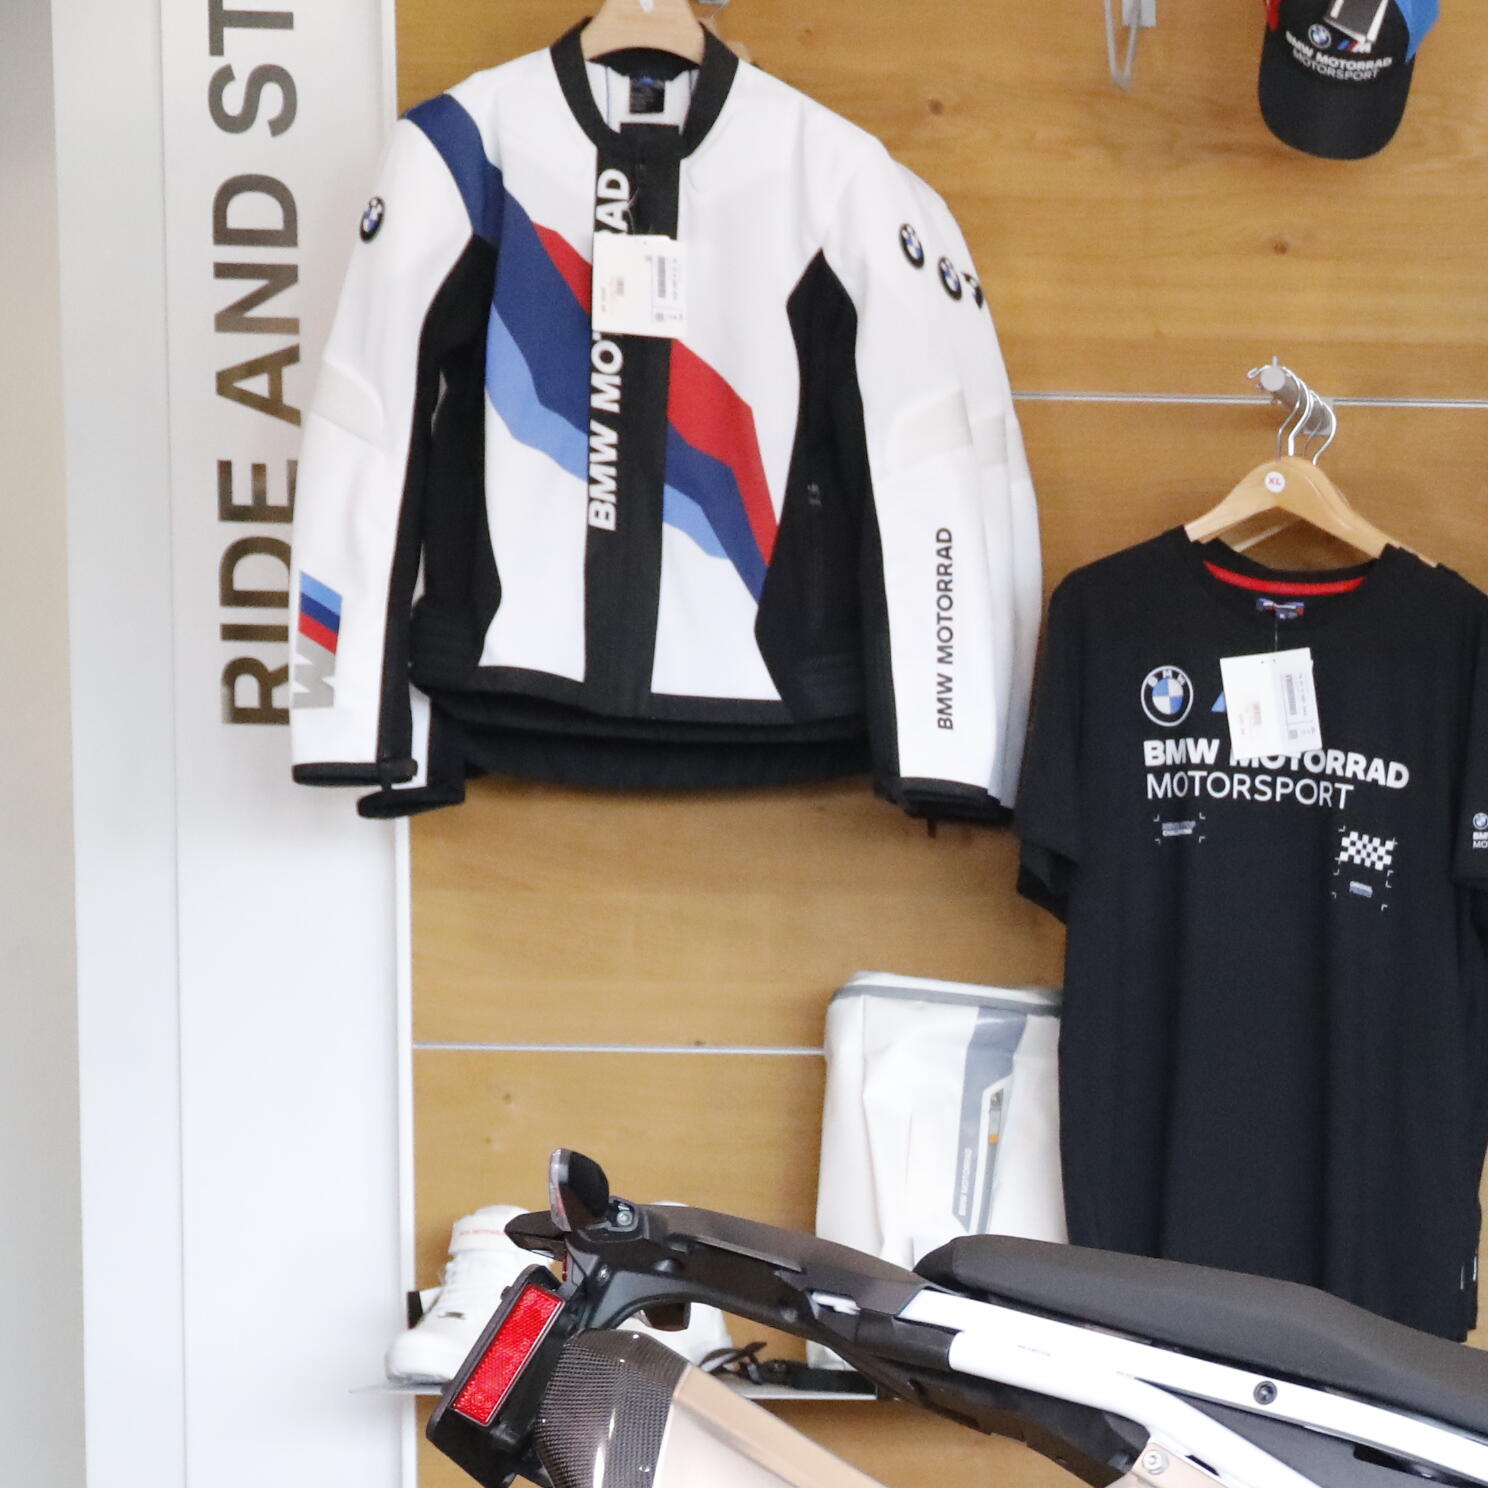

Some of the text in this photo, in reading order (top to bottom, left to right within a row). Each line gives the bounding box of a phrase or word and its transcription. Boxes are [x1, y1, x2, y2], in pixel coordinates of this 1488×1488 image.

[1292, 48, 1381, 81] MOTORSPORT
[1315, 53, 1393, 71] MOTORRAD
[213, 173, 302, 428] AND
[588, 419, 619, 532] BMW
[217, 459, 299, 725] RIDE
[936, 527, 954, 730] BMW MOTORRAD
[1143, 737, 1220, 767] BMW
[1146, 770, 1355, 810] MOTORSPORT
